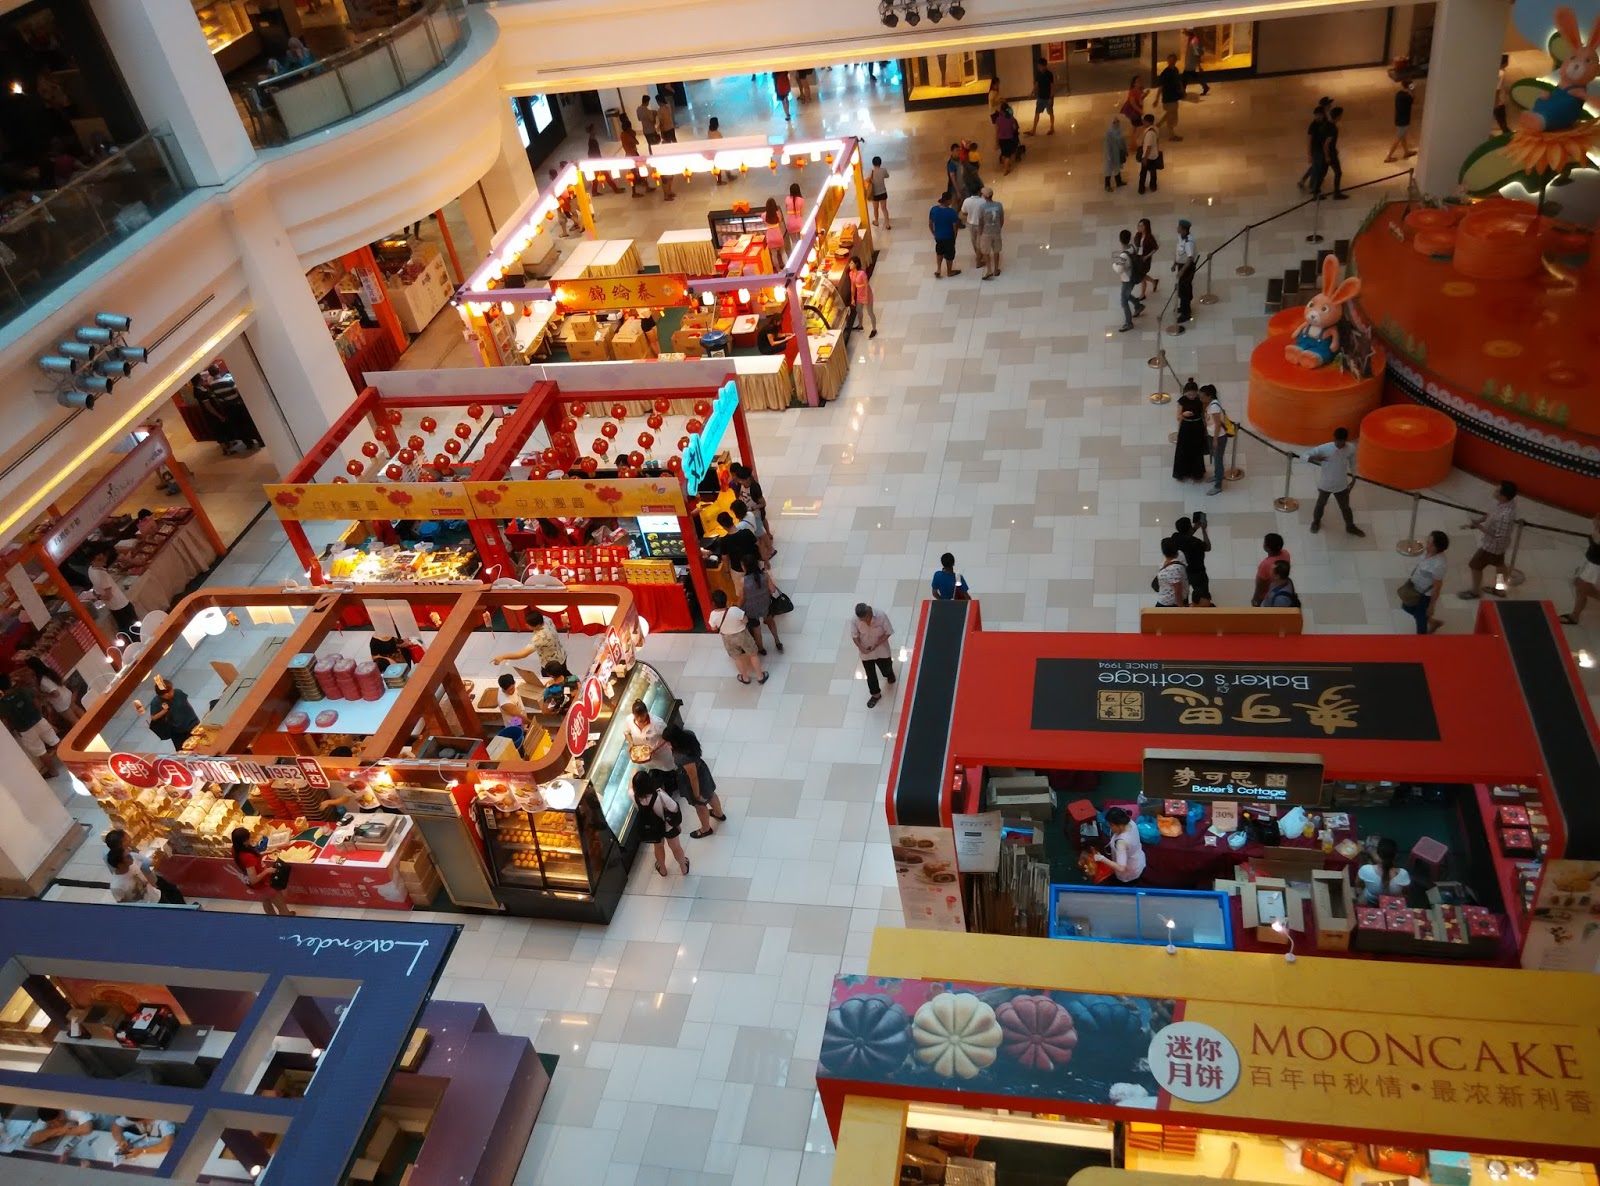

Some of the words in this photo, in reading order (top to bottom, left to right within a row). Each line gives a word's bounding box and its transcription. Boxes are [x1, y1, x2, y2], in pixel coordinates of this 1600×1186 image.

[1098, 670, 1204, 687] Cottage
[1214, 672, 1310, 691] Baker's
[236, 761, 269, 784] AH
[267, 766, 301, 780] 1952
[1191, 783, 1234, 794] Baker's
[1237, 786, 1287, 797] Cottage
[1215, 811, 1235, 819] 30%
[287, 934, 430, 977] Lavender
[1165, 1034, 1223, 1063] 迷你
[1250, 1022, 1583, 1080] MOONCAKE
[1166, 1061, 1224, 1090] 月饼
